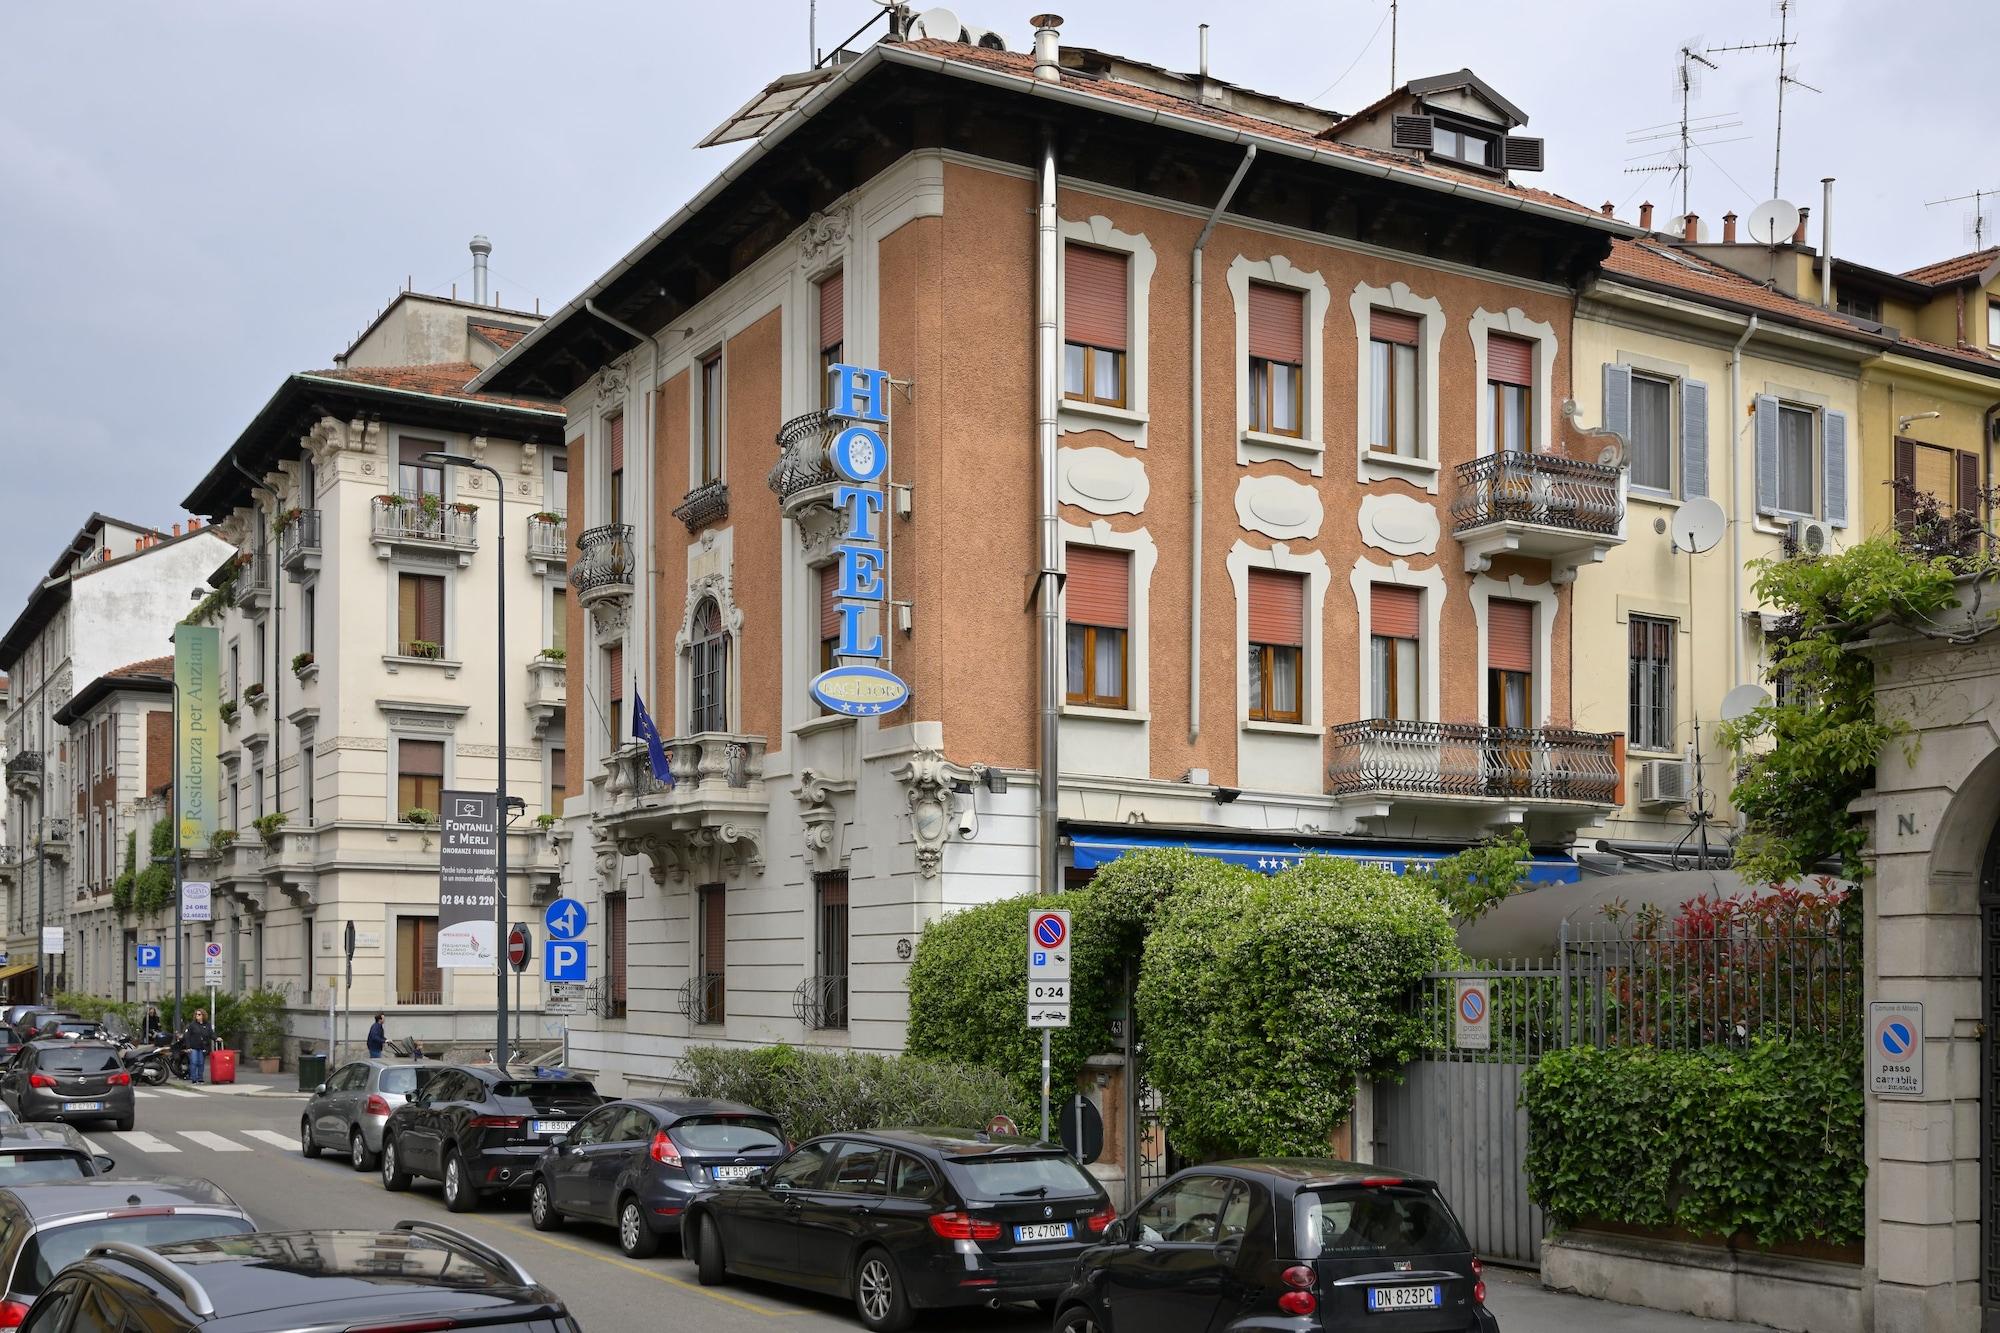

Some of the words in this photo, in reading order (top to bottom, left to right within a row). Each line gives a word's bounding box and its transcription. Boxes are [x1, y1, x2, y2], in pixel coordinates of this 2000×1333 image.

[828, 362, 889, 659] HOTEL
[185, 636, 202, 700] Anziani
[189, 705, 206, 732] per
[185, 738, 202, 820] Residenza
[446, 819, 493, 832] FONTANILI
[460, 833, 489, 845] MERLI
[442, 847, 472, 855] ONORANZE
[1360, 860, 1397, 874] HTEL
[441, 894, 452, 905] 02
[454, 895, 465, 905] 84
[466, 895, 477, 906] 63
[479, 895, 495, 906] 220
[142, 948, 156, 965] P
[554, 945, 578, 977] P
[1035, 953, 1044, 964] P
[1035, 987, 1064, 998] 0-24
[1882, 1064, 1911, 1074] passo
[1875, 1075, 1918, 1085] carrabile
[1377, 1290, 1392, 1306] DN
[1396, 1288, 1433, 1305] 823PC
